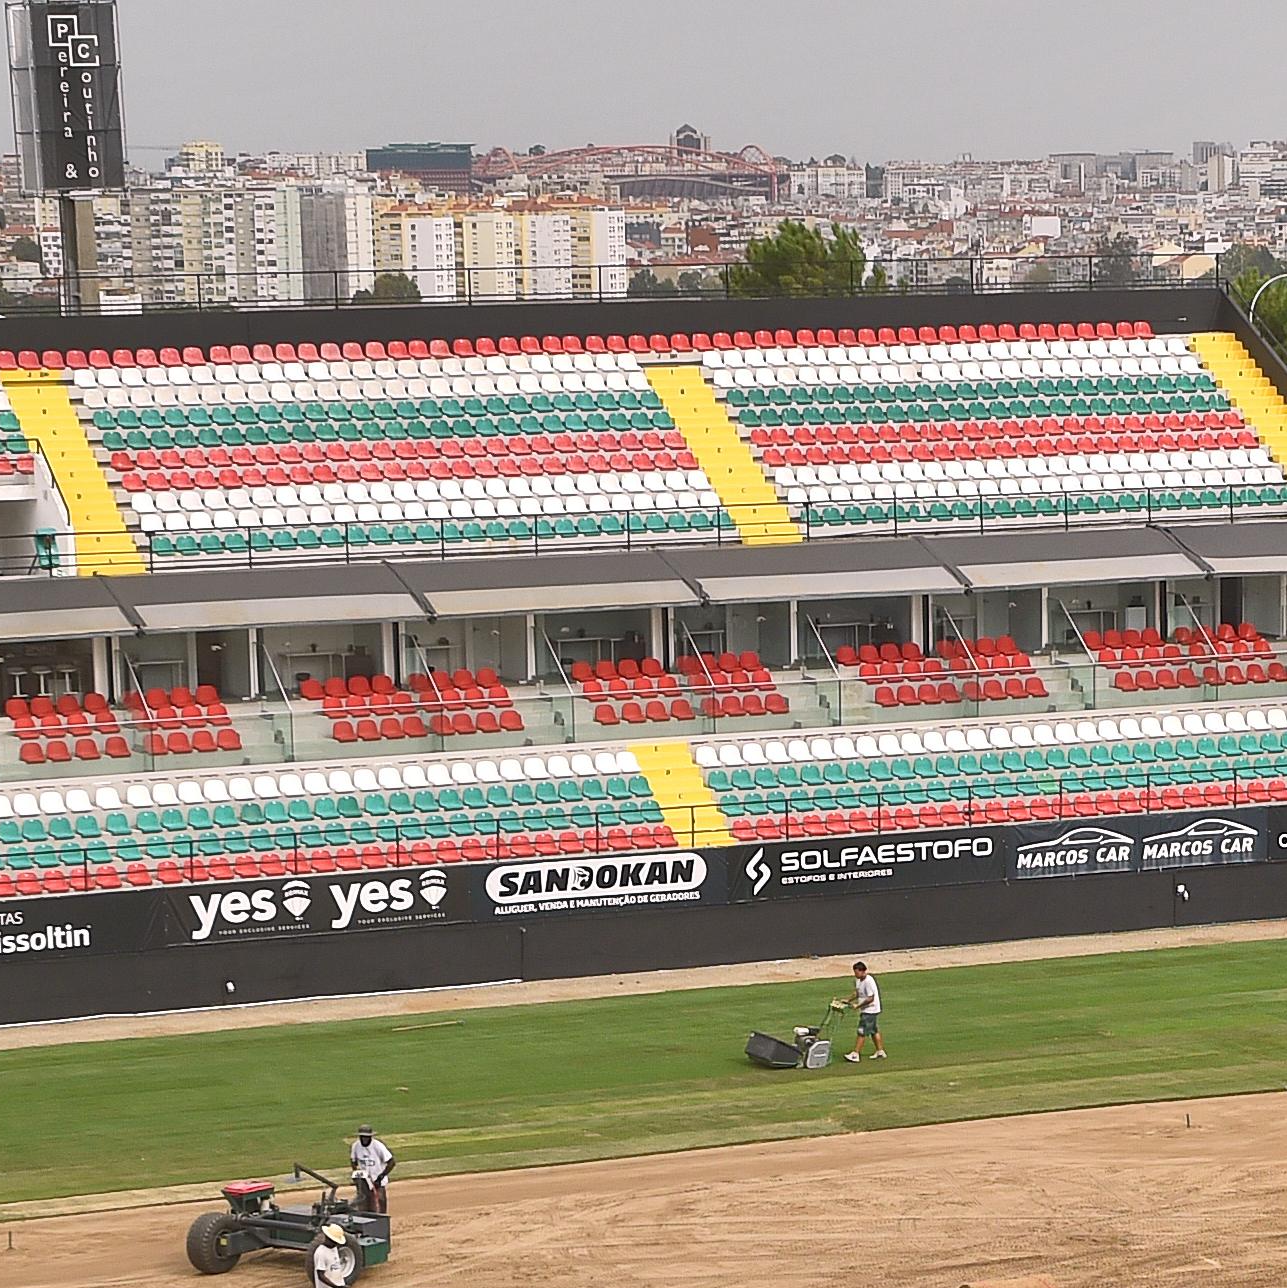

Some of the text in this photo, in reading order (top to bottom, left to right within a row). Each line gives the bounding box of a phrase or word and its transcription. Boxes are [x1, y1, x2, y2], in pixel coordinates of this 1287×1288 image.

[56, 23, 78, 179] Pereira &
[77, 43, 100, 178] Coutinho
[781, 837, 993, 872] SOLFAESTOFO
[1015, 846, 1131, 869] MARCOS CAR
[1142, 837, 1254, 860] MARCOS CAR
[498, 859, 694, 897] SANDOKAN
[781, 868, 893, 885] ESTOFOS E INTERIORES
[190, 889, 277, 940] yes
[329, 878, 414, 930] yes
[494, 903, 538, 916] ALUGUER,
[539, 900, 569, 911] VENDA
[576, 895, 637, 909] MANUTENÇÃO
[637, 895, 649, 904] DE
[649, 890, 701, 904] GERADORES
